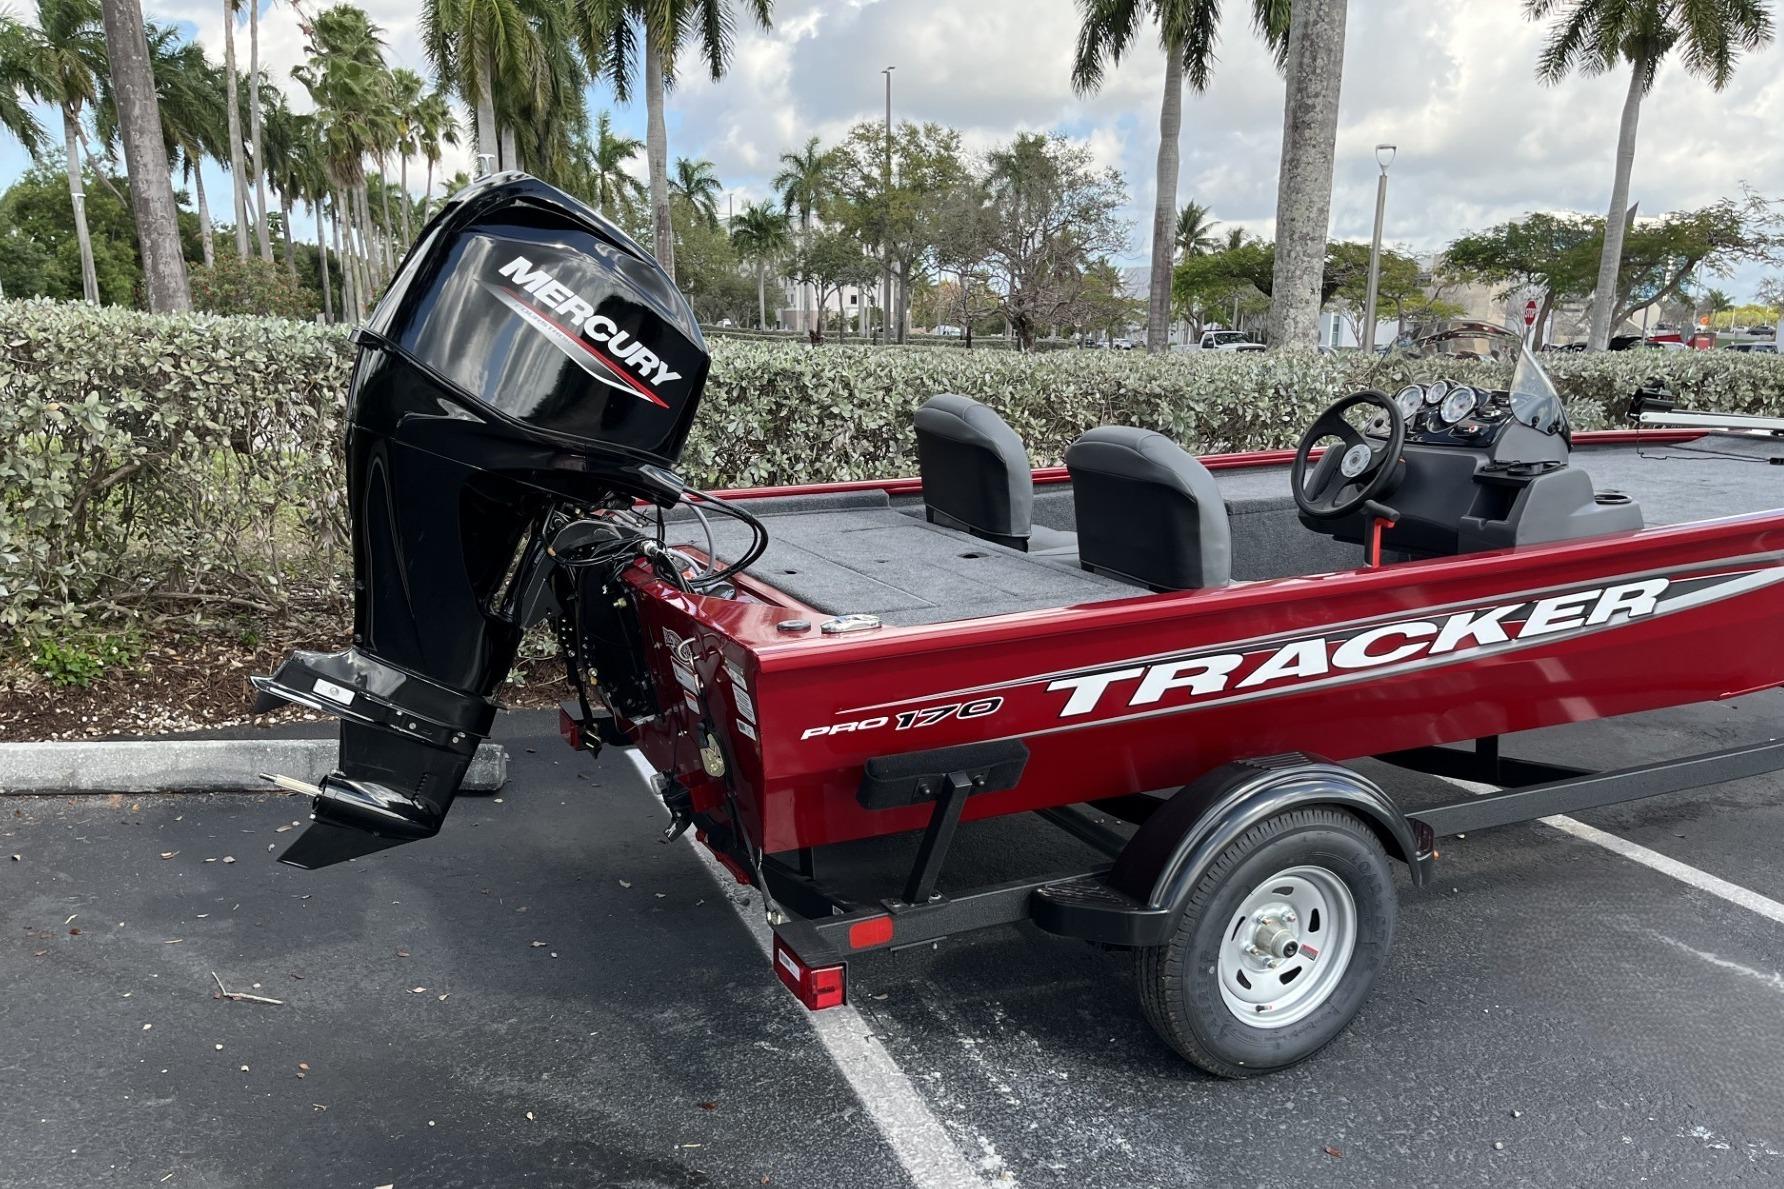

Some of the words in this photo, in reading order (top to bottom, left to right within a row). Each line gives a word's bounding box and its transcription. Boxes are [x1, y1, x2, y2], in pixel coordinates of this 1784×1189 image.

[498, 256, 682, 387] MERCURY
[1046, 578, 1671, 718] TRACKER
[800, 716, 889, 741] PRO
[894, 696, 1005, 731] 170
